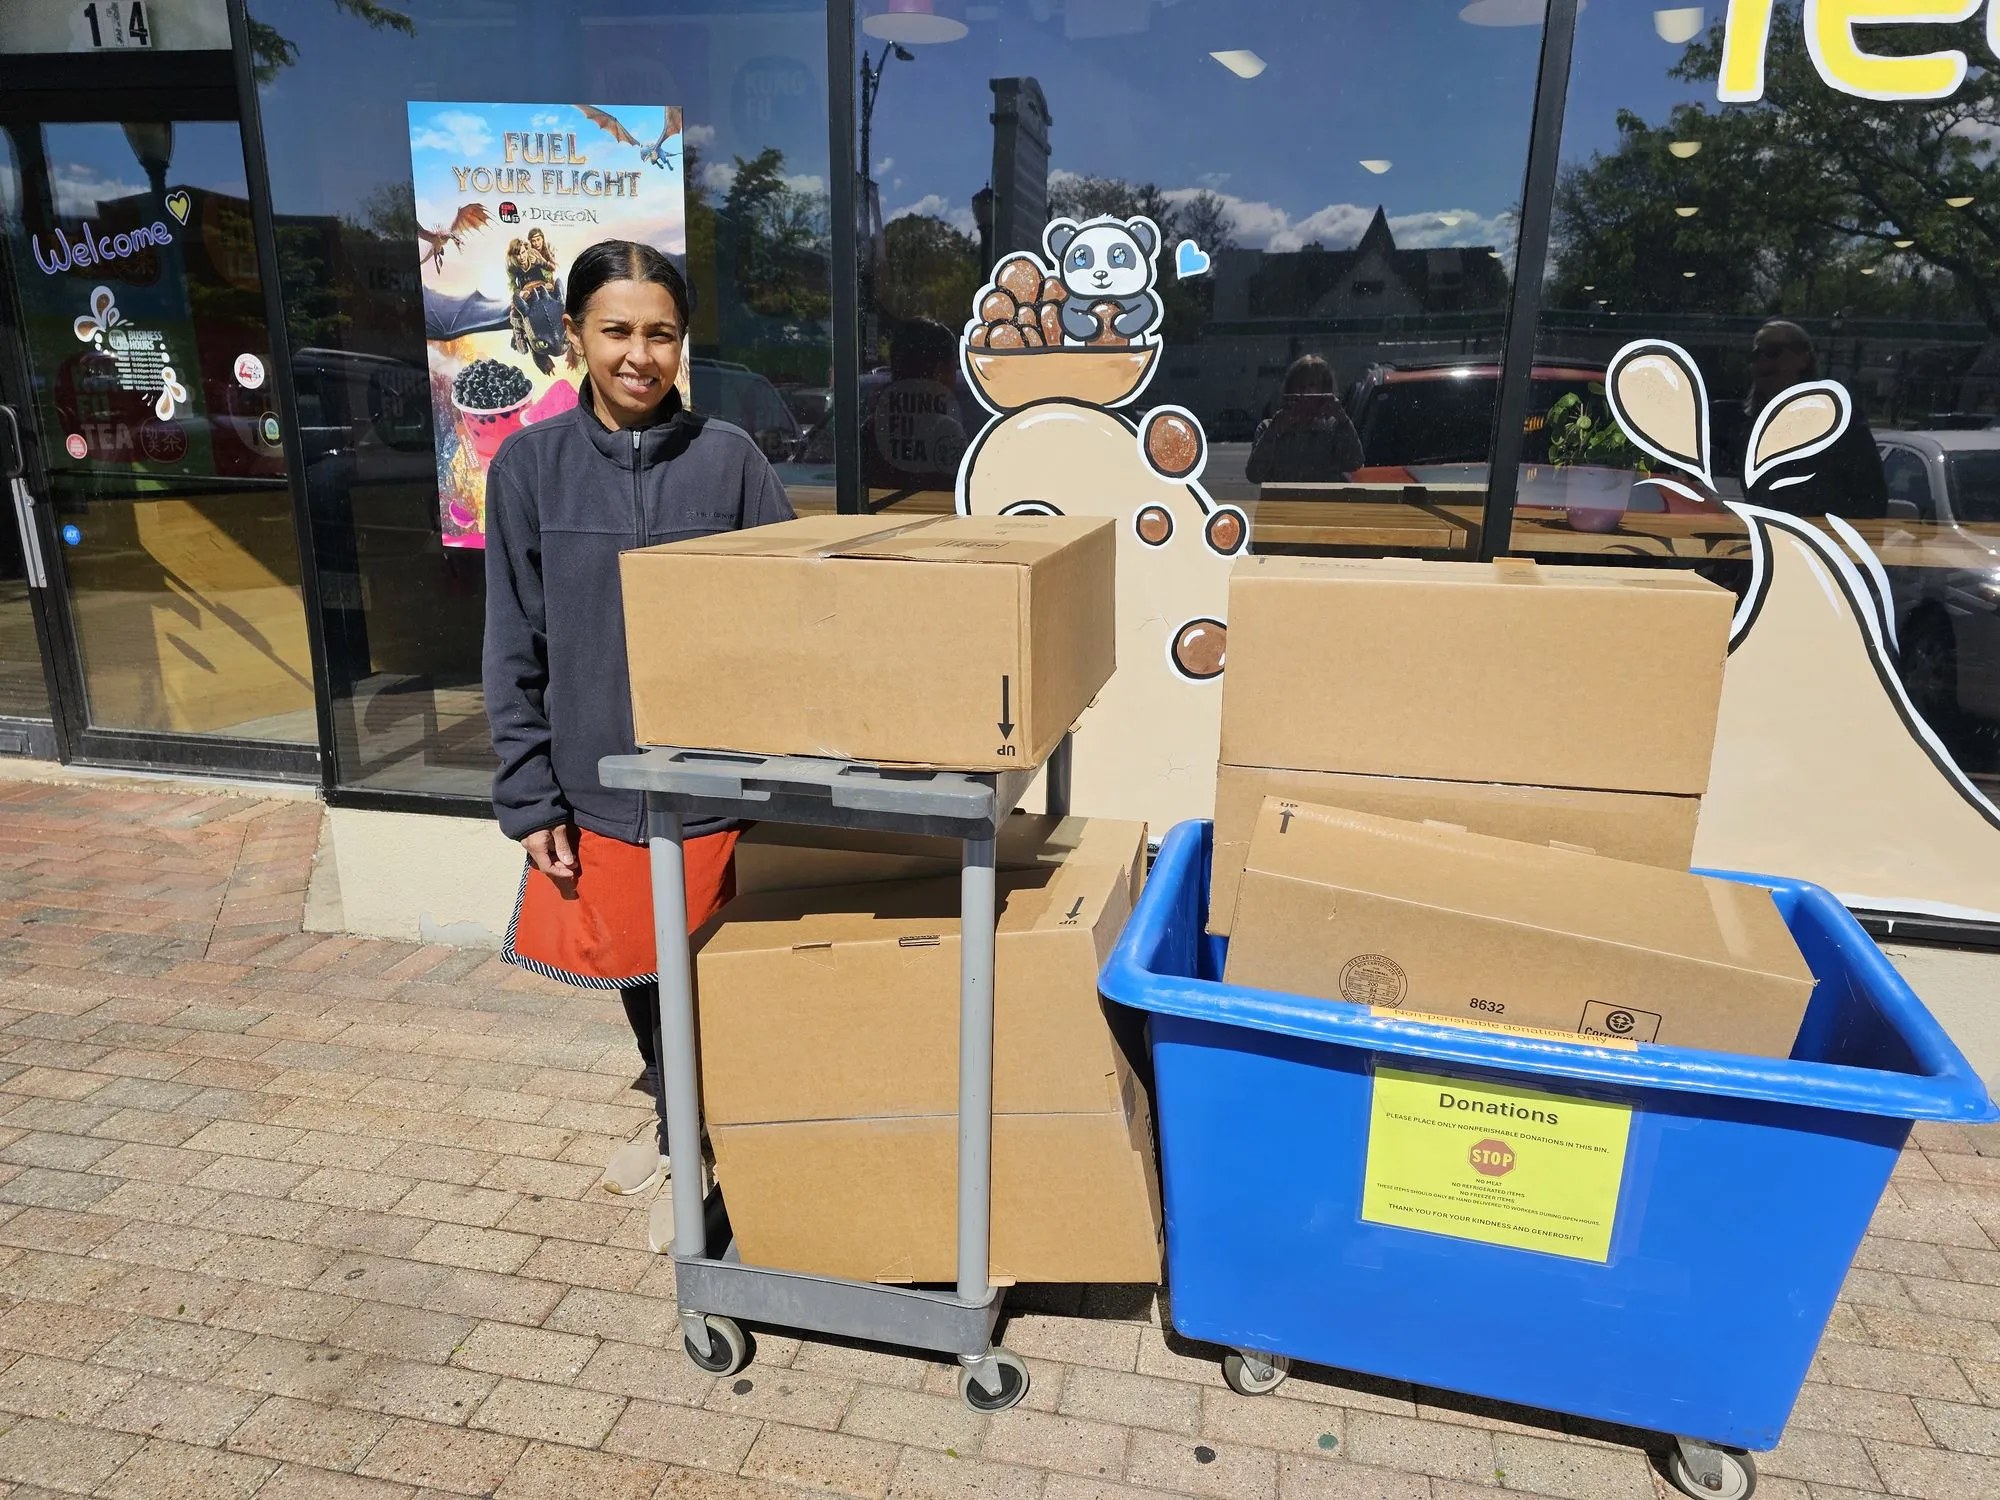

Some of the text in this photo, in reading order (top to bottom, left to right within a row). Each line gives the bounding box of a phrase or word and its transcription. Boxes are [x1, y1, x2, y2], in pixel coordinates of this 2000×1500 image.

[503, 132, 588, 165] FUEL
[452, 165, 642, 197] YOUR FLIGHT
[529, 207, 600, 224] DRAGON
[32, 220, 173, 275] Welcome
[128, 330, 163, 341] BUSINESS
[129, 340, 155, 350] HOURS
[889, 391, 947, 415] KUNG
[80, 423, 134, 450] TEA
[889, 415, 914, 437] FU
[889, 438, 928, 461] TEA
[997, 745, 1015, 756] UP
[1469, 998, 1505, 1014] 8632
[1394, 1009, 1607, 1043] Non-perishable donations only
[1439, 1093, 1559, 1125] Donations
[1386, 1112, 1412, 1121] PLEASE
[1413, 1116, 1436, 1126] PLACE
[1437, 1121, 1457, 1129] ONLY
[1457, 1124, 1518, 1138] NONPERISHABLE
[1520, 1133, 1564, 1146] DONATIONS
[1575, 1143, 1593, 1151] THIS
[1593, 1146, 1610, 1154] BIN.
[1472, 1149, 1513, 1167] STOP
[1462, 1183, 1506, 1195] REFRIGERATED
[1470, 1191, 1496, 1200] FREEZER
[1497, 1196, 1515, 1204] ITEMS
[1377, 1182, 1393, 1190] THESE
[1410, 1189, 1432, 1197] SHOULD
[1472, 1199, 1502, 1208] DELIVERED
[1511, 1206, 1539, 1215] WORKERS
[1539, 1211, 1562, 1220] DURING
[1388, 1203, 1584, 1242] THANK YOU FOR YOUR KINDNESS AND GENEROSITY!
